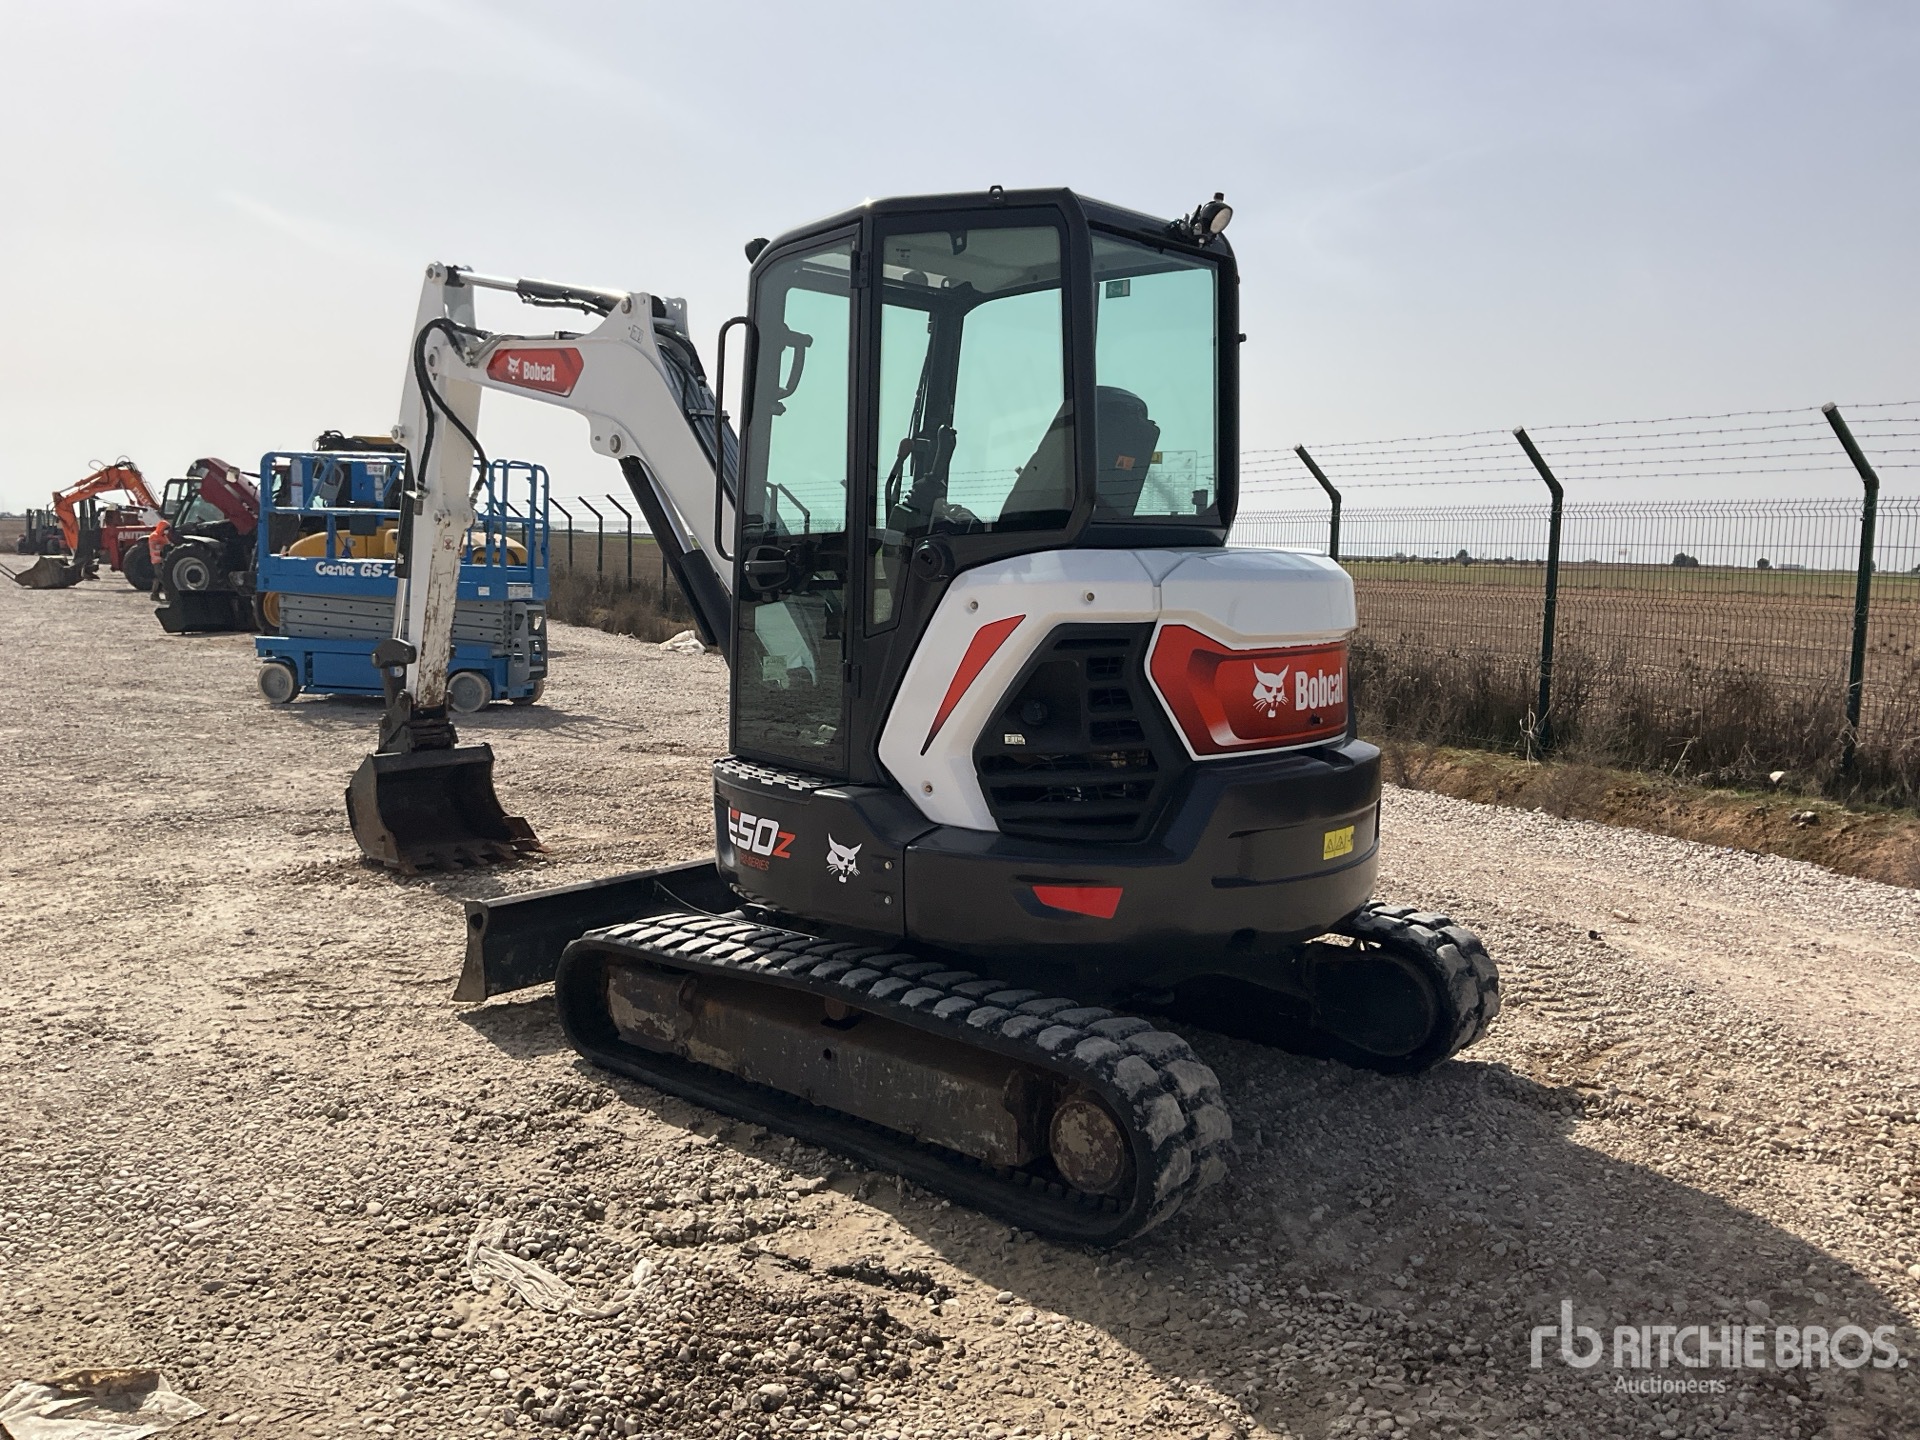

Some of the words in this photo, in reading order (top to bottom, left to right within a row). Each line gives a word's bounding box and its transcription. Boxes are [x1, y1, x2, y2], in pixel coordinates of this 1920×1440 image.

[523, 361, 556, 382] Bobcat
[315, 561, 355, 576] Genie
[1295, 667, 1343, 711] Bobcat
